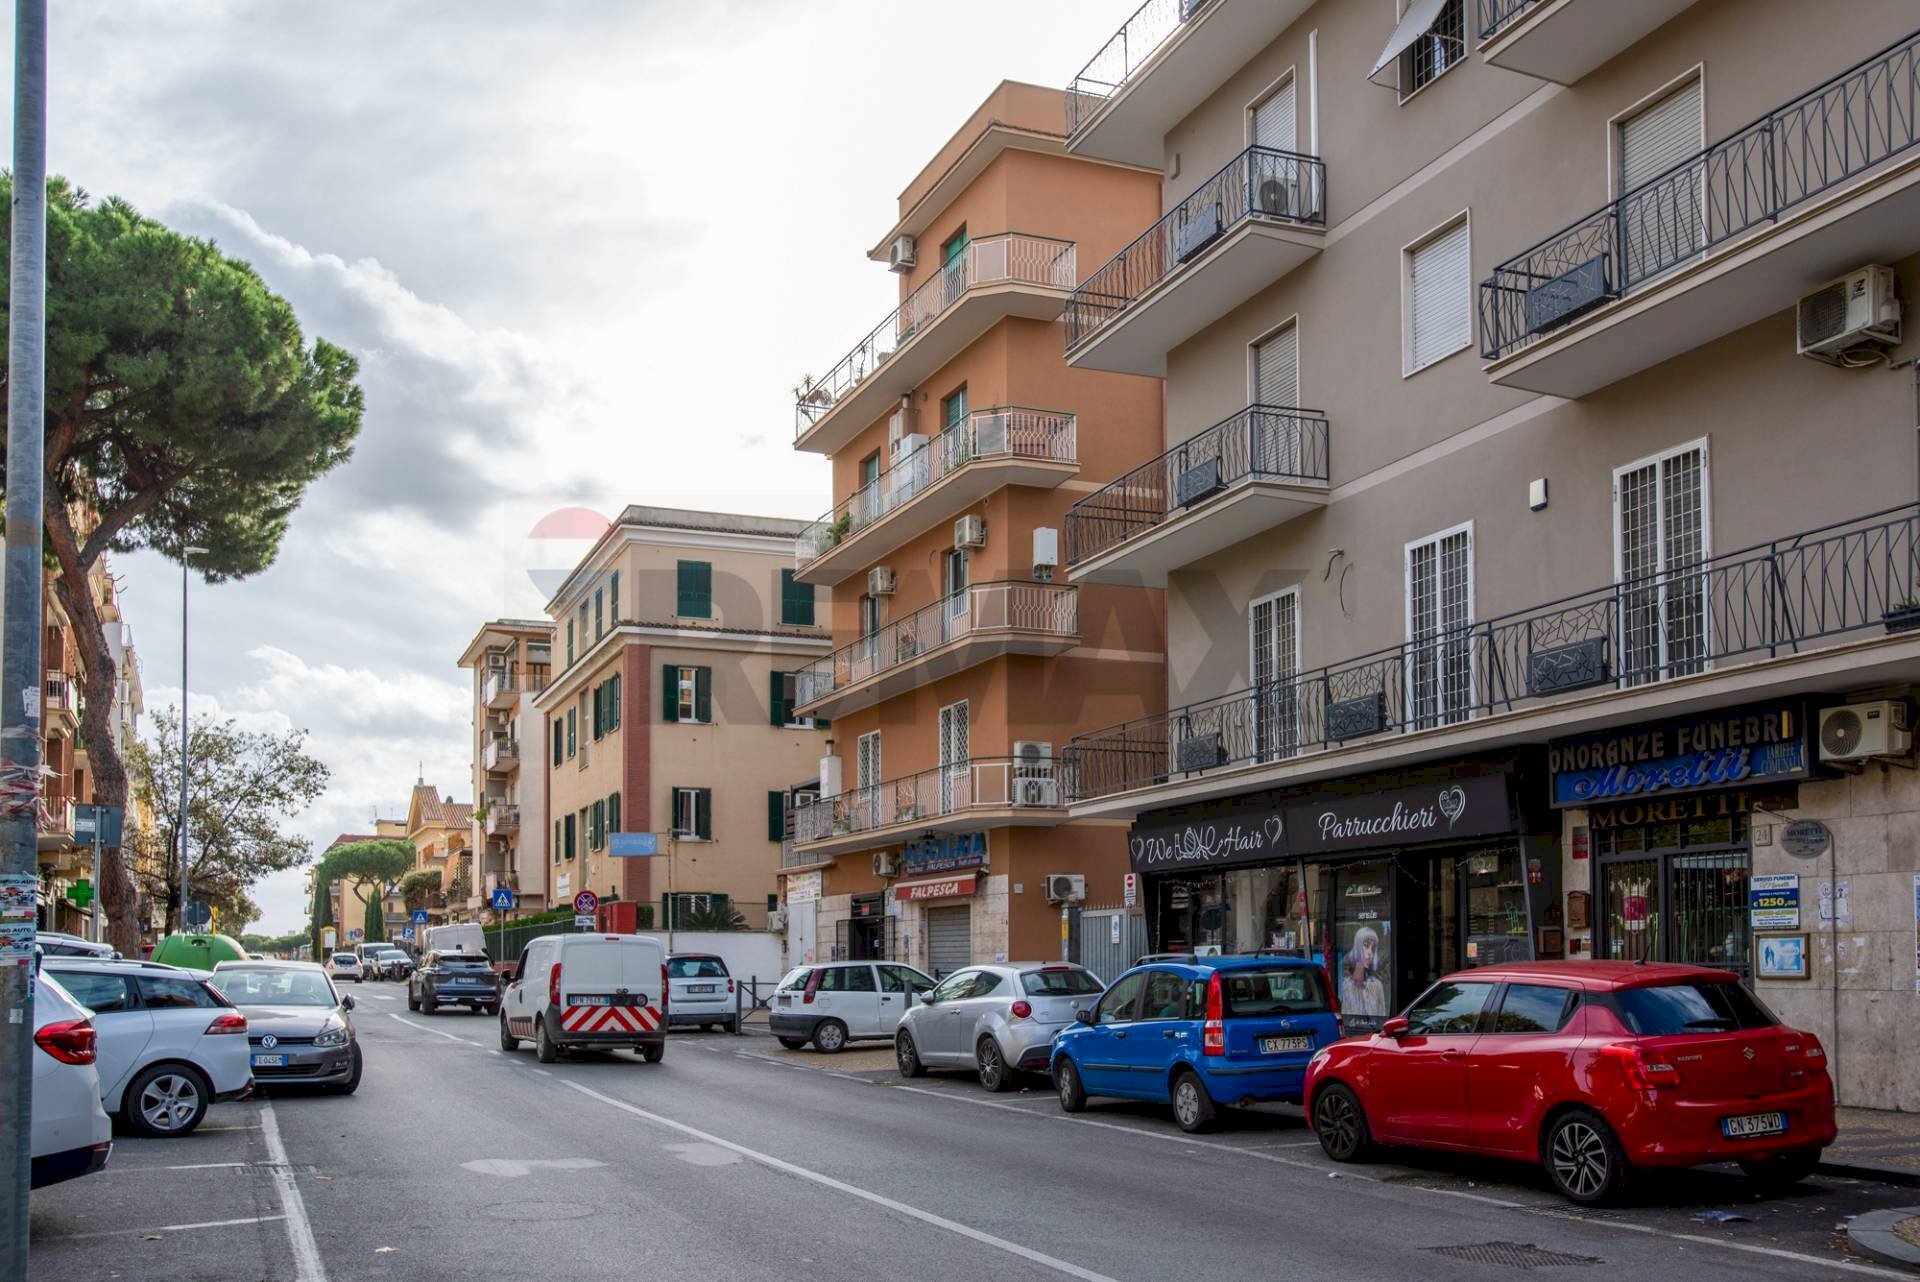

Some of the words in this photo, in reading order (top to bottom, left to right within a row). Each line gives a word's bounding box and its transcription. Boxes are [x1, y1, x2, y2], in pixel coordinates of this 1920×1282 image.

[1549, 732, 1665, 774] ONORANZE
[1677, 710, 1794, 755] FUNEBRI
[1571, 748, 1752, 801] Moretti
[1318, 801, 1438, 841] Parrucchieri
[1589, 792, 1749, 829] MORETTI
[1147, 840, 1173, 864] We
[1219, 826, 1265, 857] Hair
[910, 882, 960, 899] FALPESCA
[1267, 1040, 1279, 1050] CX
[1281, 1038, 1307, 1049] 773PS
[1730, 1119, 1744, 1134] GN
[1746, 1114, 1781, 1131] 375WD
